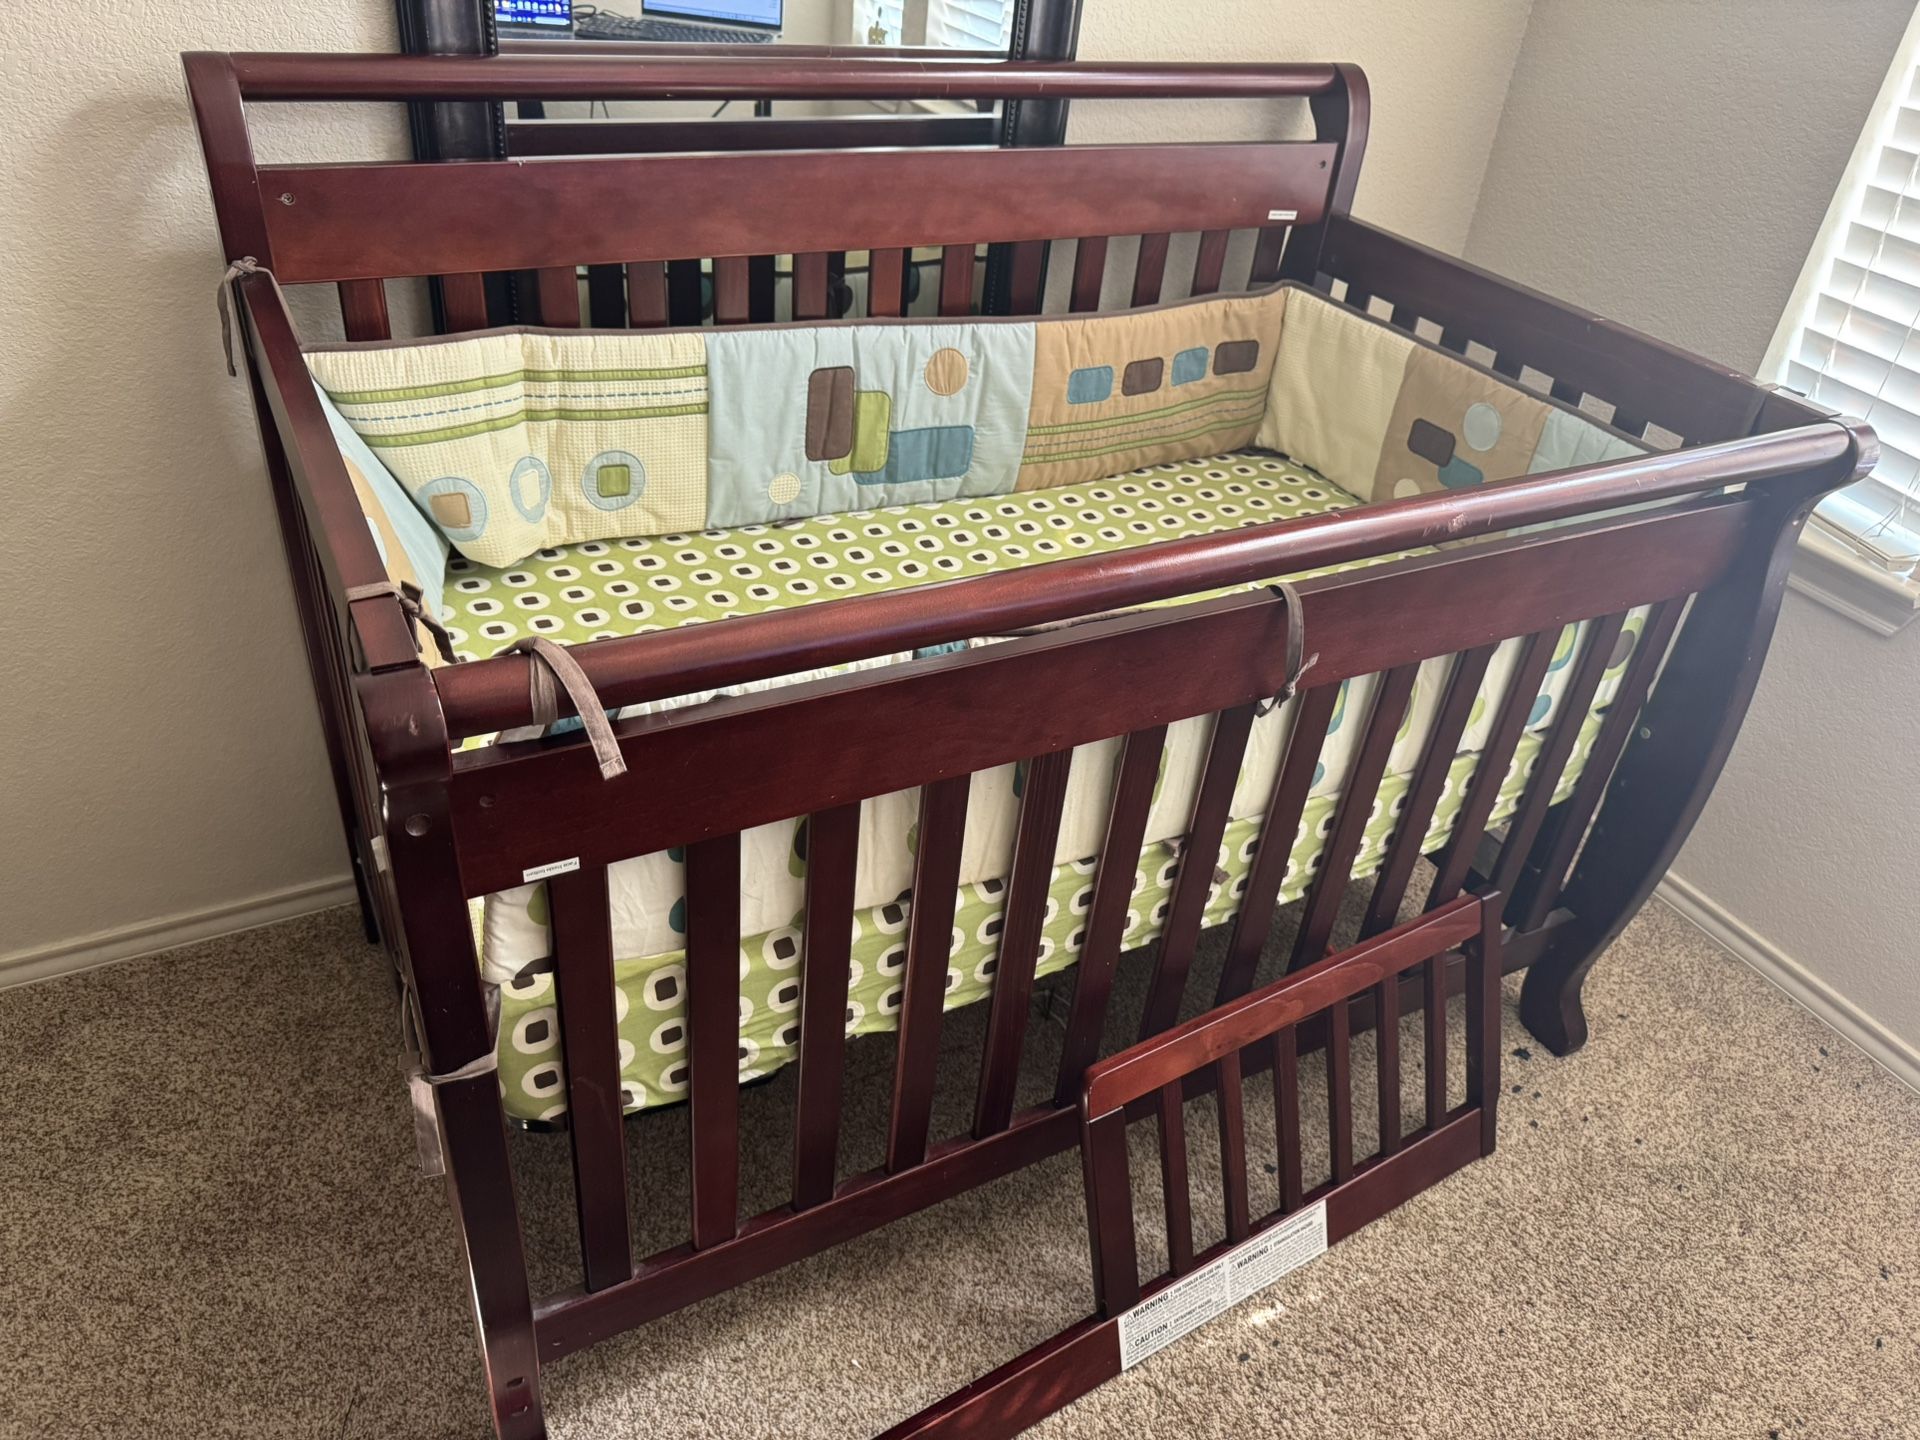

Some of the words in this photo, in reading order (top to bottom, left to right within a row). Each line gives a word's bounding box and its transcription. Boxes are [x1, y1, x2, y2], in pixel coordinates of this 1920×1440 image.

[1236, 1245, 1269, 1269] WARNING
[1132, 1292, 1169, 1318] WARNING
[1134, 1322, 1168, 1347] CAUTION
